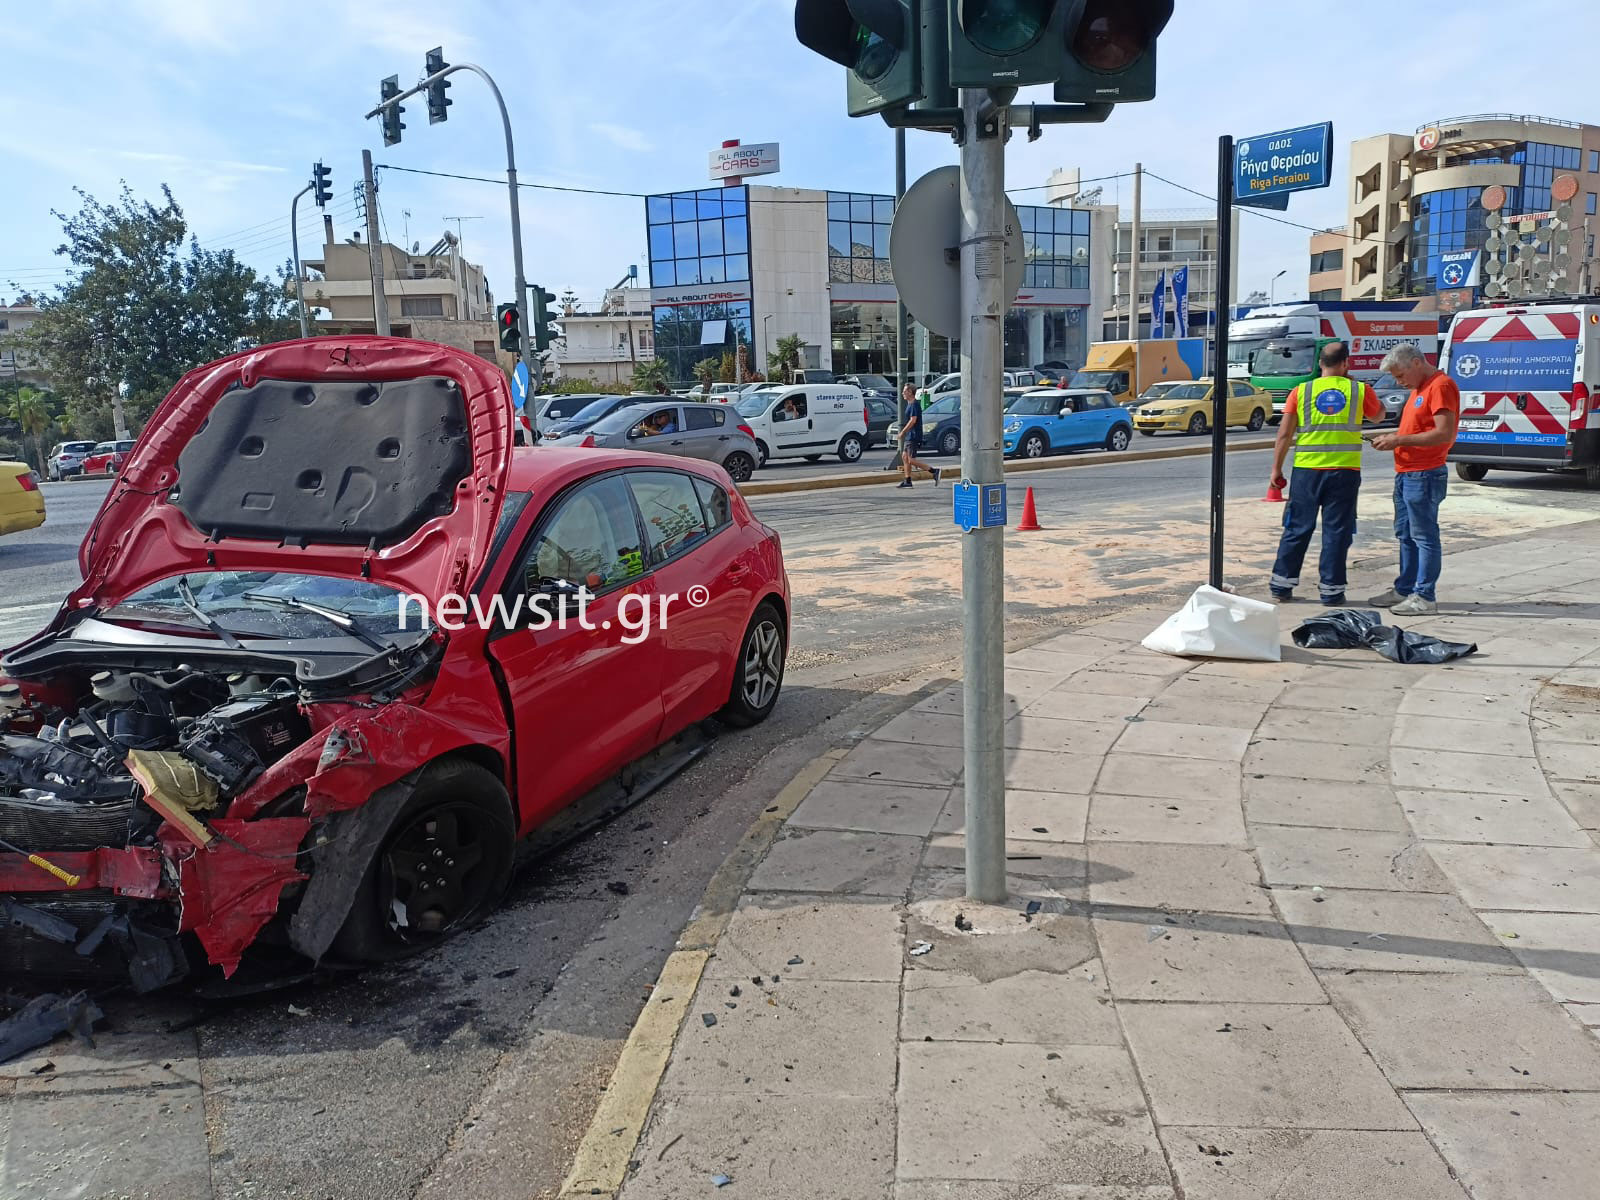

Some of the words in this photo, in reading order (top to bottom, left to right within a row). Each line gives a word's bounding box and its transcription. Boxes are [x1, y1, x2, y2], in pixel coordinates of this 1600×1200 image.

[1269, 138, 1292, 151] ΟΔΟΣ
[733, 149, 764, 158] ABOUT
[722, 157, 760, 171] CARS
[1240, 158, 1269, 177] Ρήγα
[1271, 149, 1319, 172] Φεραίου
[1250, 178, 1271, 190] Riga
[1273, 172, 1310, 186] Feraiou
[708, 291, 733, 299] CARS
[1524, 355, 1573, 364] ΔΗΜΟΚΡΑΤΙΑ
[1534, 435, 1559, 443] SAFETY
